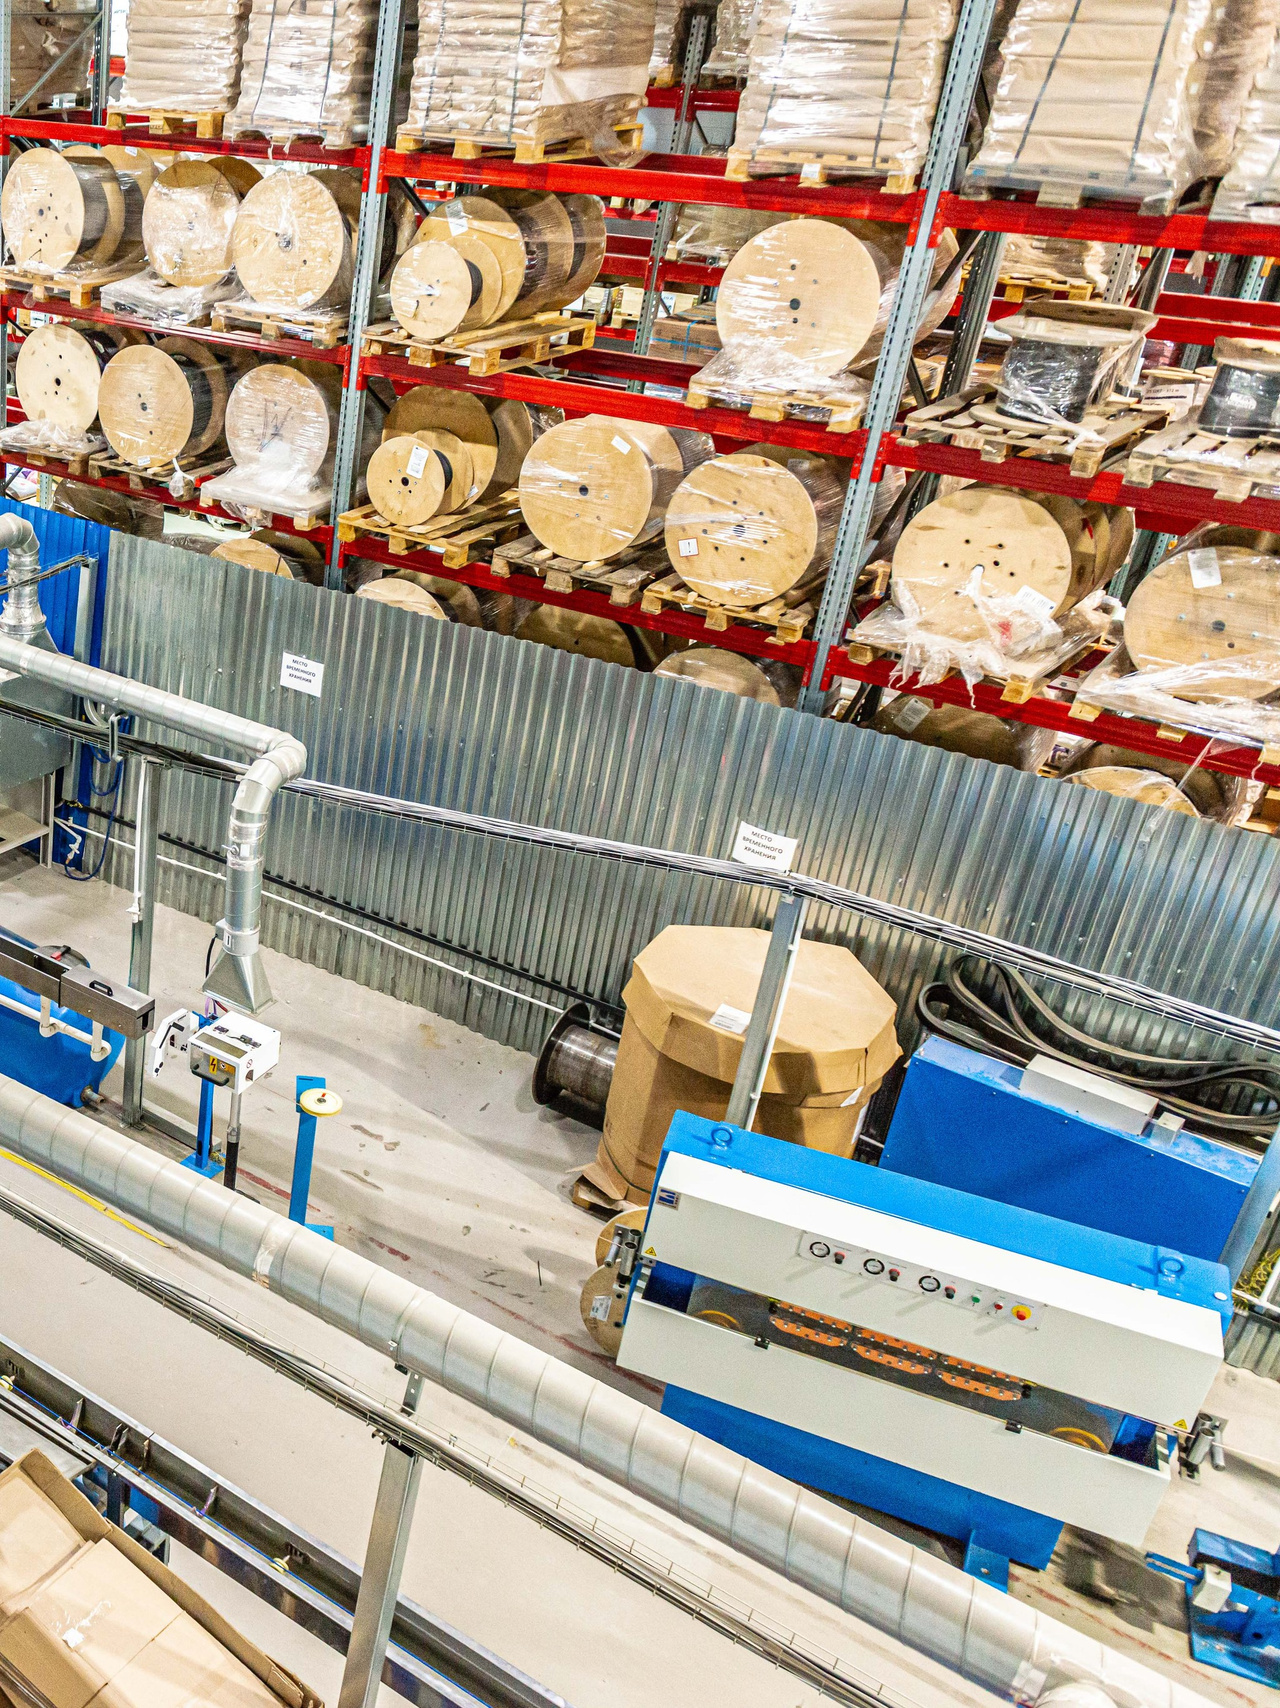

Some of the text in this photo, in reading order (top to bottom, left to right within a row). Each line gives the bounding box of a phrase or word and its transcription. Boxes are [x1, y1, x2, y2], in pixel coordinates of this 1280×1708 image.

[292, 659, 308, 668] МЕСТО
[751, 831, 773, 842] МЕСТО
[742, 836, 783, 854] ВРЕМЕННОГО
[744, 846, 777, 860] ХРАНЕНИЯ
